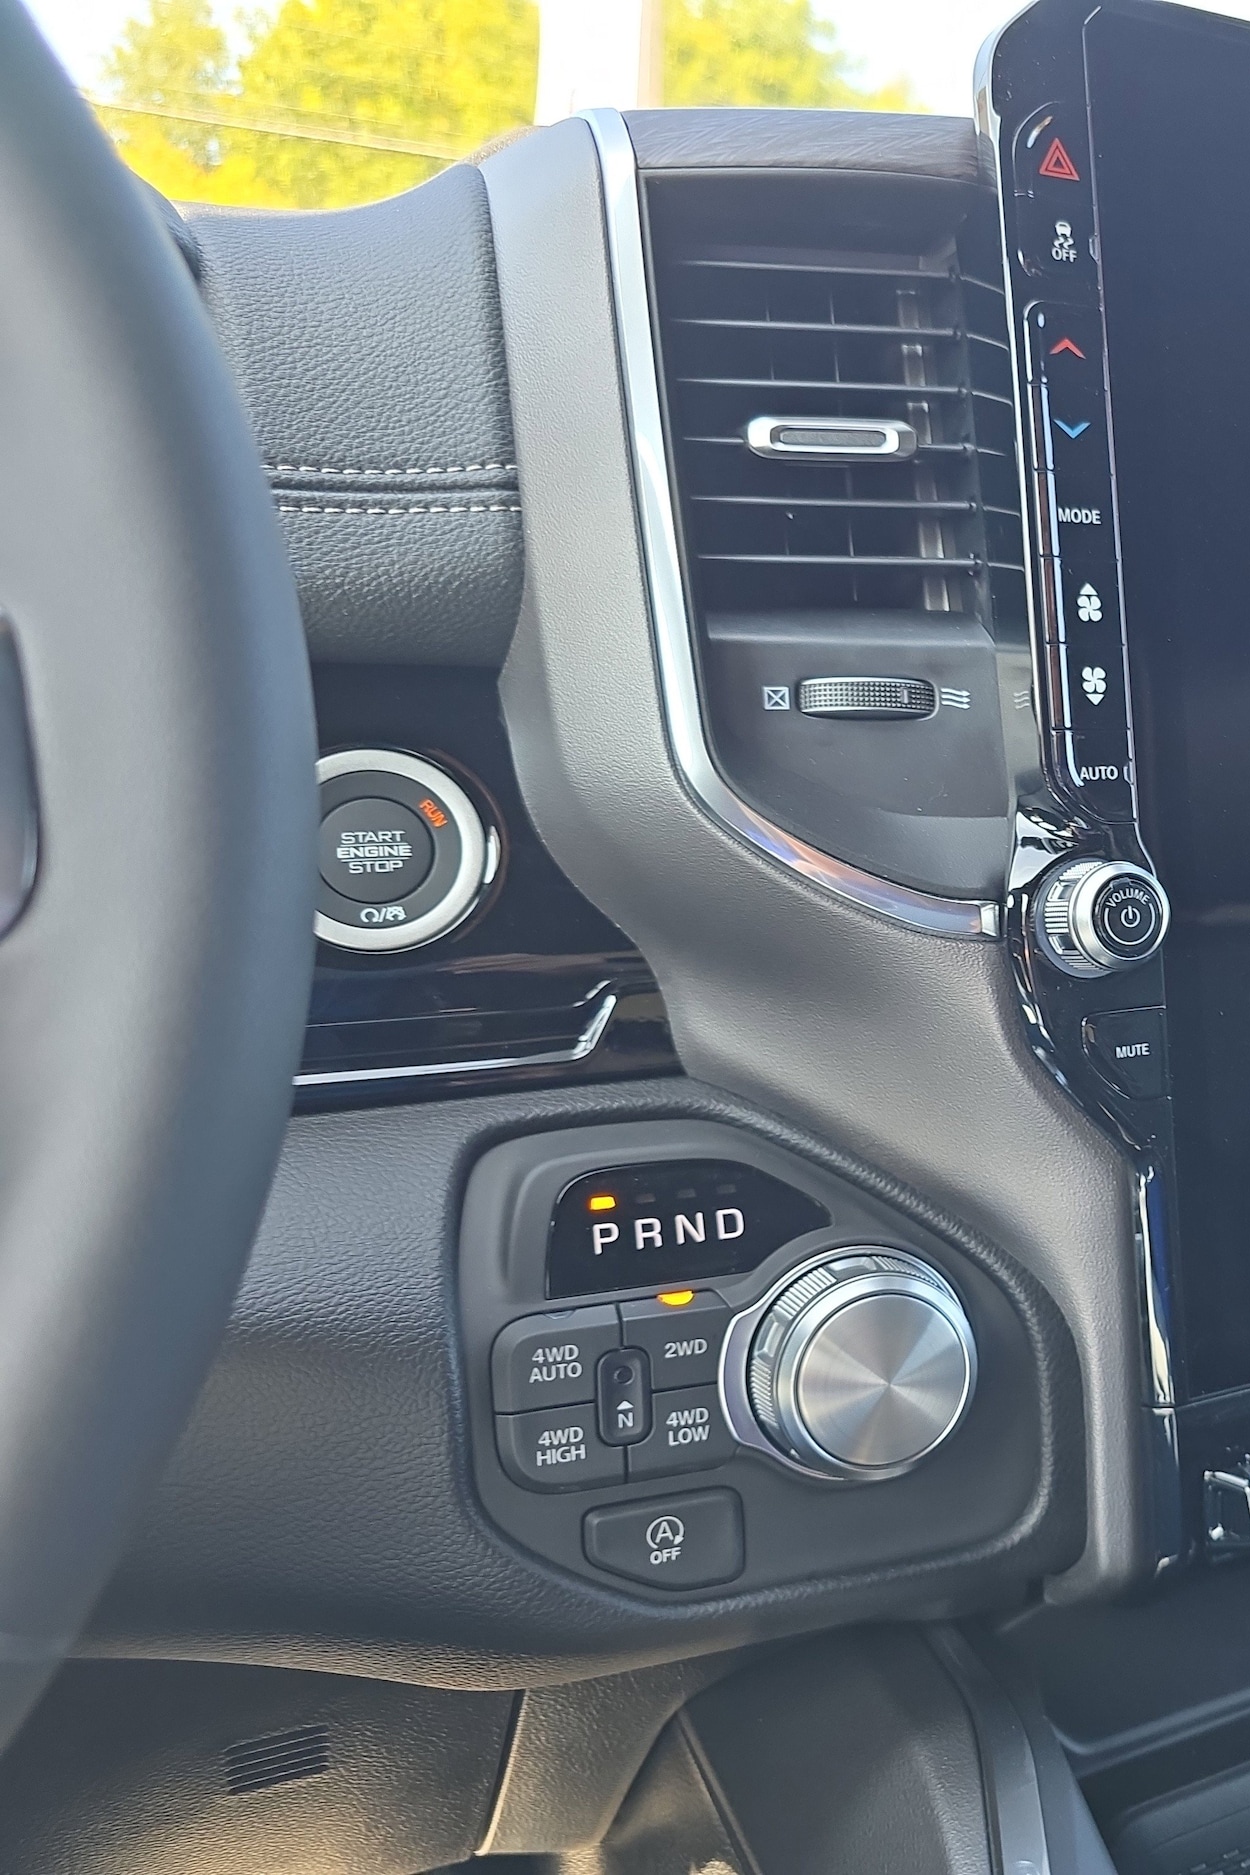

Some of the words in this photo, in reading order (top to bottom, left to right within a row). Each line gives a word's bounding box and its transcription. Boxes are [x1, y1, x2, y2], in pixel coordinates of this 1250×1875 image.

[1052, 249, 1077, 262] OFF
[1058, 508, 1101, 525] MODE
[1080, 766, 1118, 781] AUTO
[419, 798, 448, 828] RUN
[341, 831, 405, 844] START
[336, 845, 413, 859] ENGINE
[349, 861, 403, 874] STOP
[1106, 888, 1150, 909] VOLUME
[1115, 1043, 1150, 1058] MUTE
[592, 1222, 620, 1256] P
[634, 1217, 663, 1250] R
[674, 1211, 706, 1245] N
[715, 1207, 746, 1240] D
[532, 1344, 579, 1364] 4WD
[664, 1338, 708, 1359] 2WD
[528, 1361, 583, 1384] AUTO
[617, 1411, 634, 1429] N
[665, 1407, 709, 1428] 4WD
[538, 1426, 584, 1447] 4WD
[668, 1424, 710, 1447] LOW
[536, 1444, 586, 1466] HIGH
[649, 1547, 682, 1565] OFF
